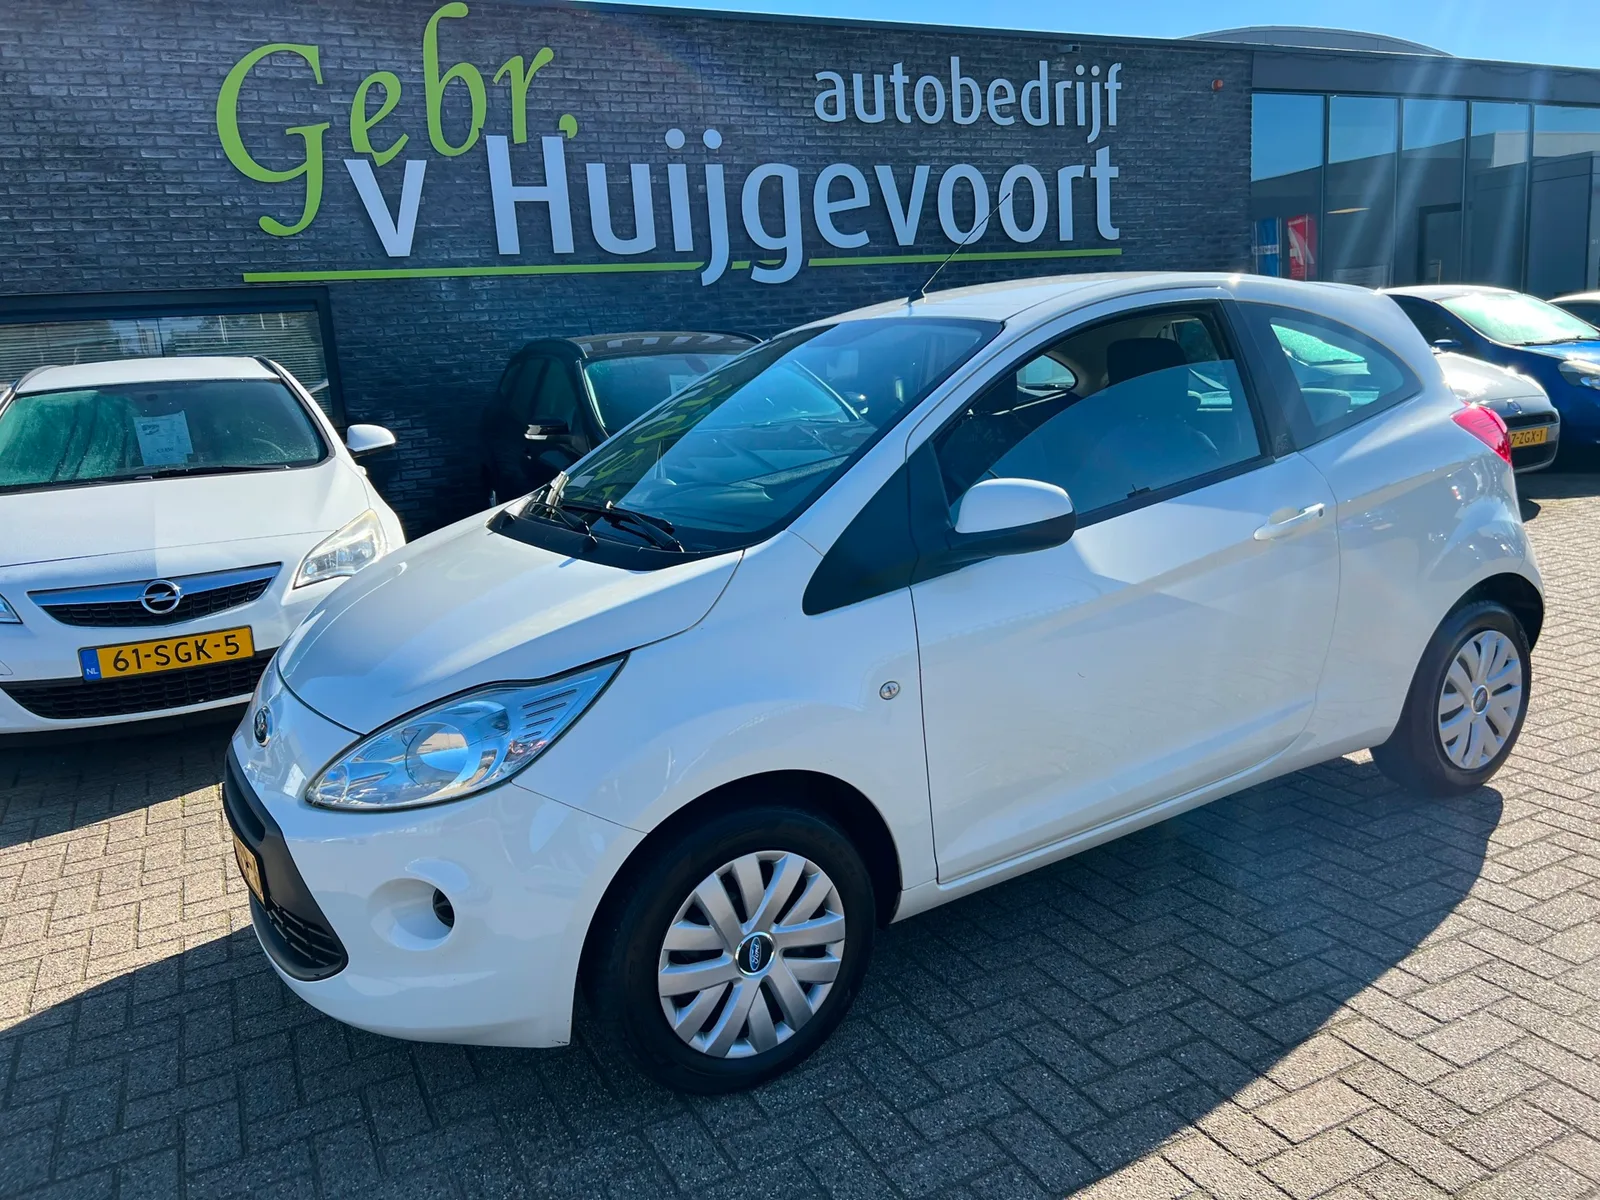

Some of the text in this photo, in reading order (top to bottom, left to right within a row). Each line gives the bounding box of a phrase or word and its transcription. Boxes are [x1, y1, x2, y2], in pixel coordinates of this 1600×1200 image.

[216, 2, 578, 237] Gebr.
[814, 56, 1122, 144] autobedrijf
[343, 129, 1120, 287] v Huijgevoort
[112, 634, 240, 672] 61-SGK-5
[751, 944, 760, 964] Ford
